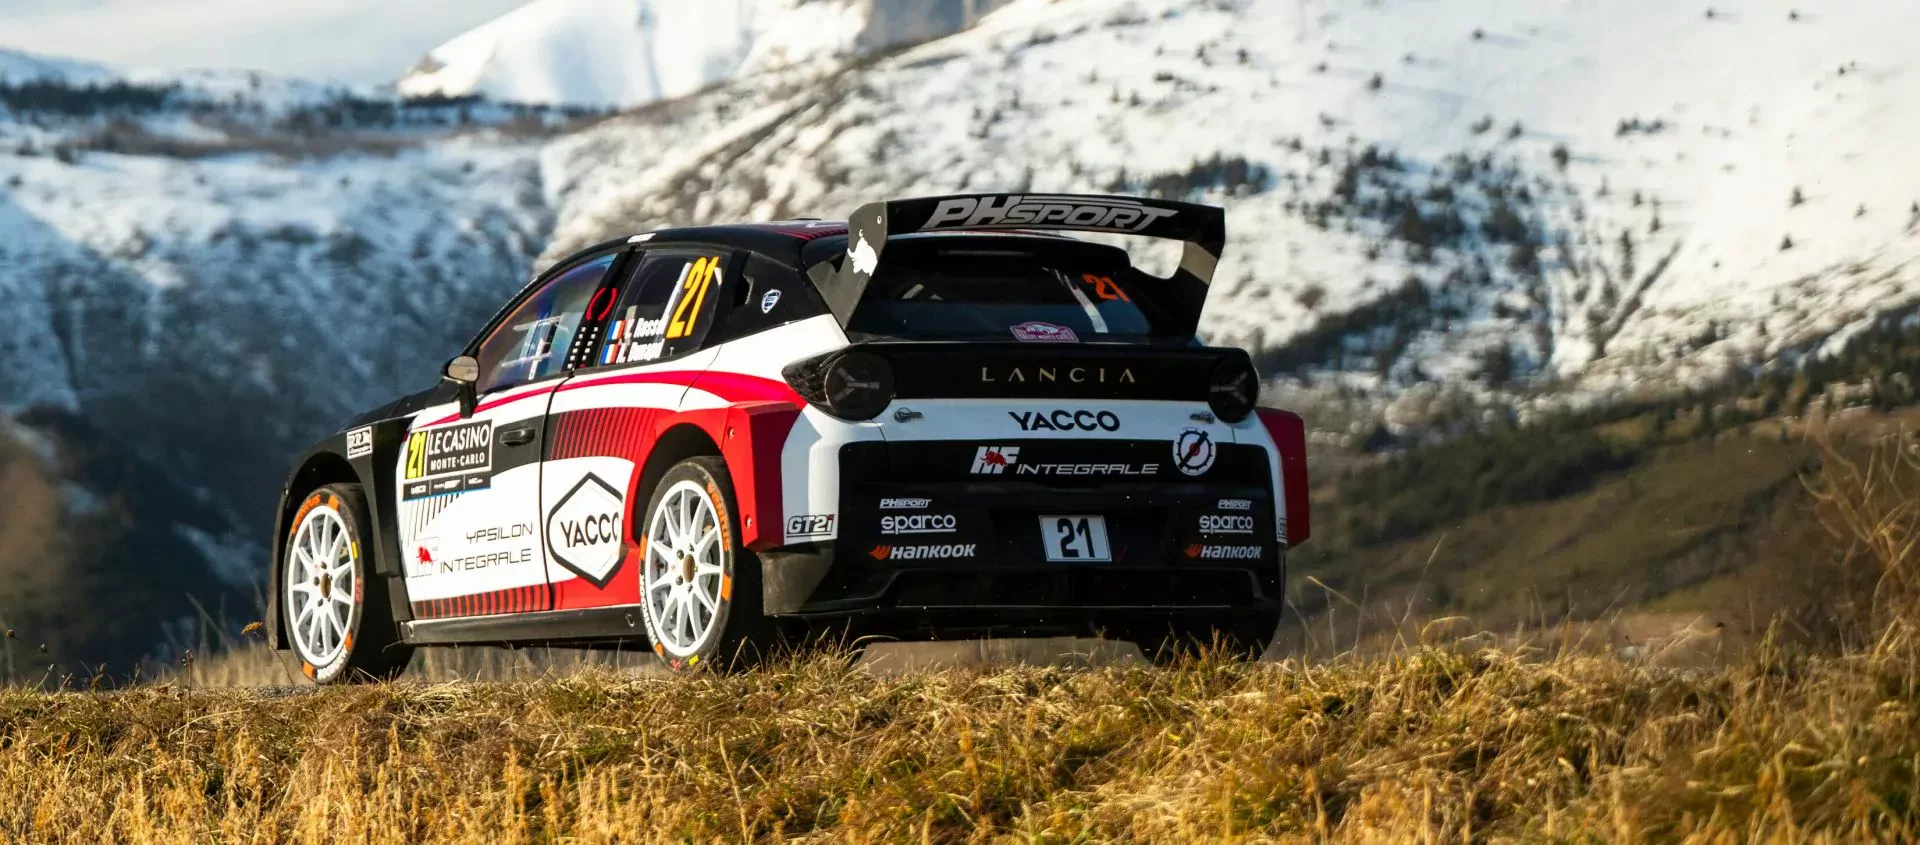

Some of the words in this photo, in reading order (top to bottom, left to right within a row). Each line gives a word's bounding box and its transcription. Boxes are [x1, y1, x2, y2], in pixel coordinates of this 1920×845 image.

[918, 195, 1178, 231] PHSPORT
[665, 256, 719, 339] 21
[1081, 273, 1130, 303] 21
[981, 367, 1136, 383] LANCIA
[1008, 410, 1120, 432] YACCO
[428, 431, 442, 455] LE
[442, 424, 490, 453] CASINO
[405, 431, 427, 480] 21
[1016, 463, 1159, 475] INTEGRALE
[466, 522, 533, 544] YPSILON
[786, 514, 834, 534] GT2i
[881, 514, 957, 535] sparco
[1199, 515, 1253, 534] sparco
[1056, 517, 1096, 558] 21
[440, 548, 532, 574] INTEGRALE
